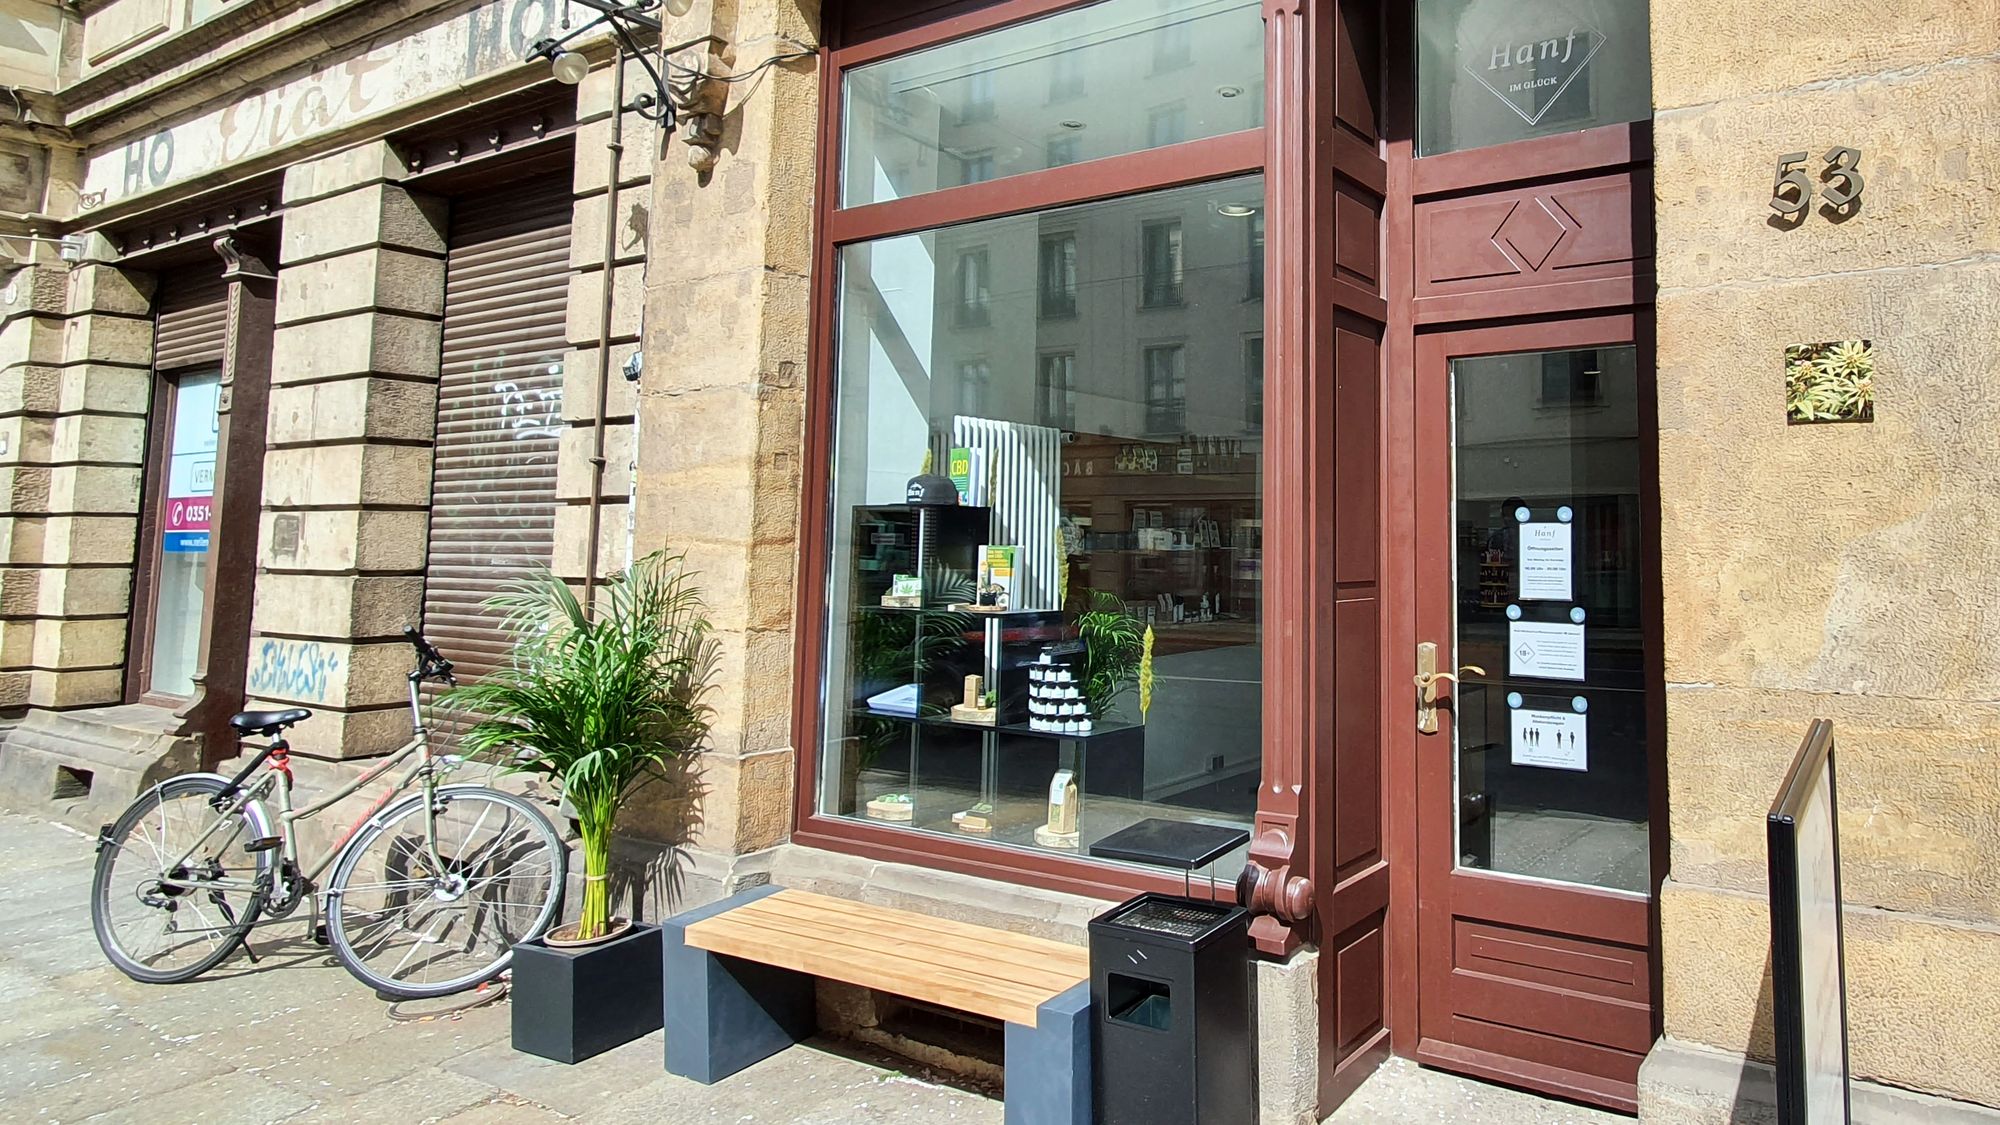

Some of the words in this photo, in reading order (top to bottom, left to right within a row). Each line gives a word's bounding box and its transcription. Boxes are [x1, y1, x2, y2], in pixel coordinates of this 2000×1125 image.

[1487, 26, 1577, 70] Hanf
[1509, 83, 1522, 92] IM
[122, 126, 174, 196] HO
[1769, 145, 1864, 213] 53
[951, 459, 969, 476] CBD
